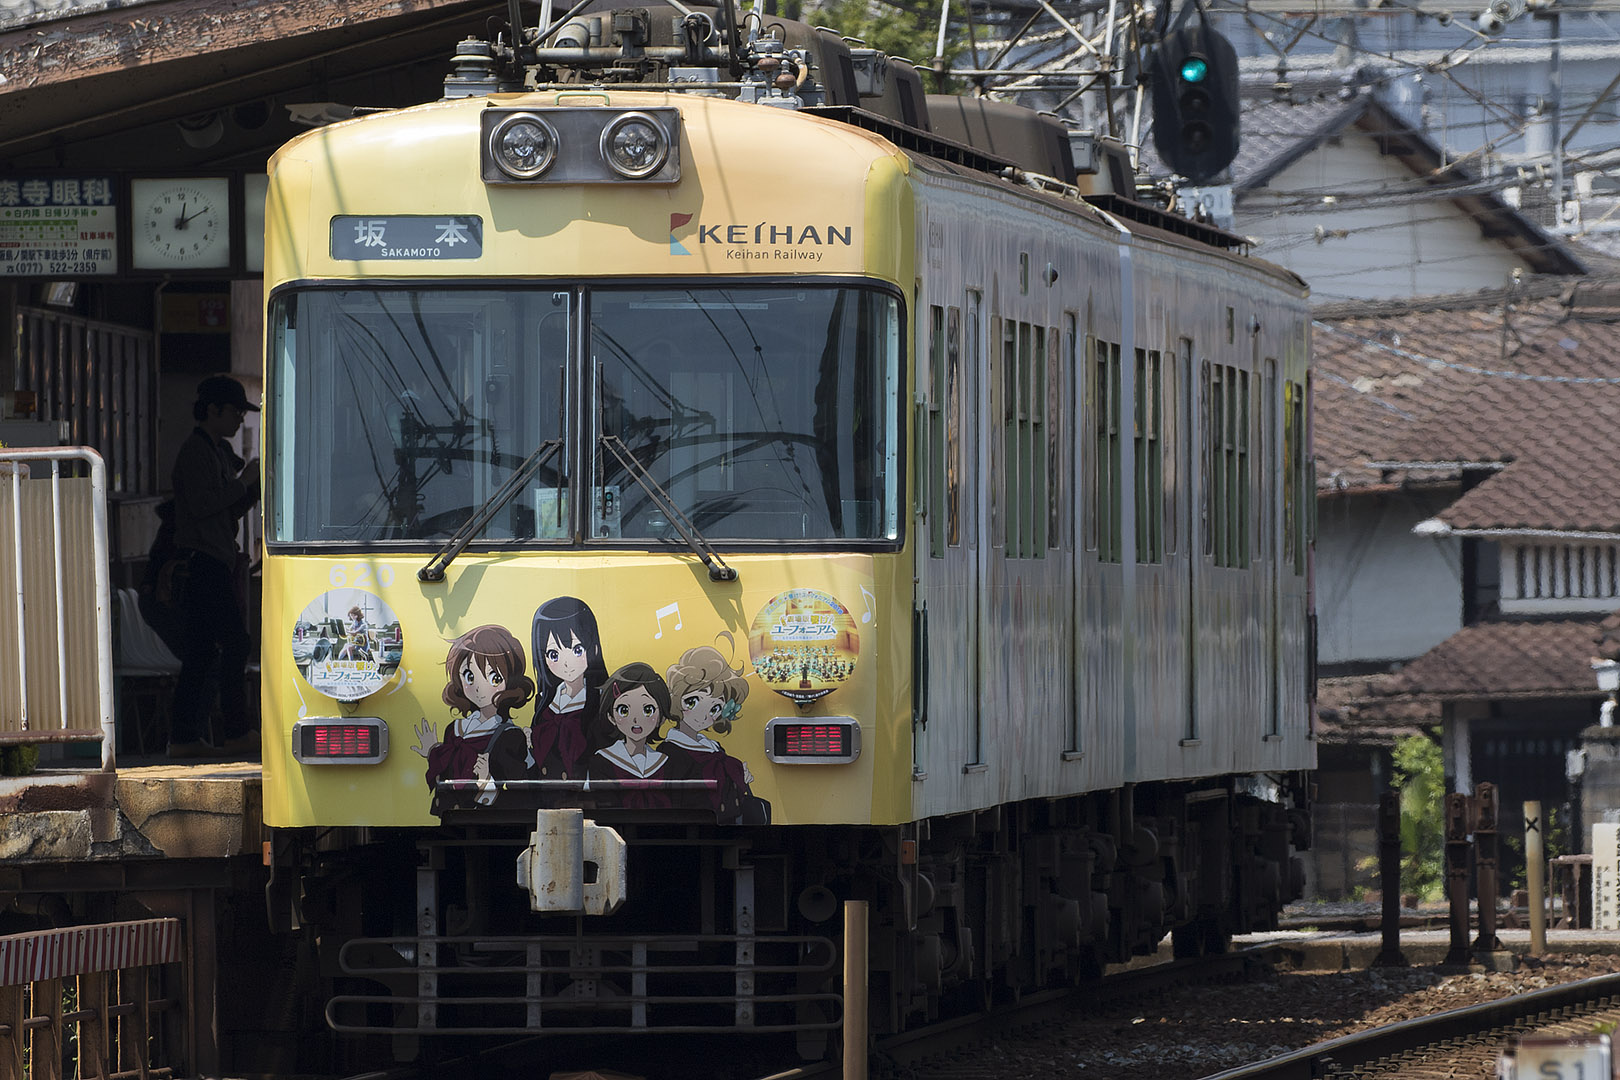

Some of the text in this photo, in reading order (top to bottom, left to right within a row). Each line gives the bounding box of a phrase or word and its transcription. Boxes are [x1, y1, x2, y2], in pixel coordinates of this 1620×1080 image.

[700, 222, 852, 246] KEIHAN
[381, 248, 440, 257] SAKAMOTO
[726, 250, 823, 262] Keihan Railway
[50, 262, 97, 273] 522-2359
[329, 563, 396, 588] 620
[771, 624, 837, 635] ユーフォニアム
[316, 671, 382, 682] ユーフォニアム
